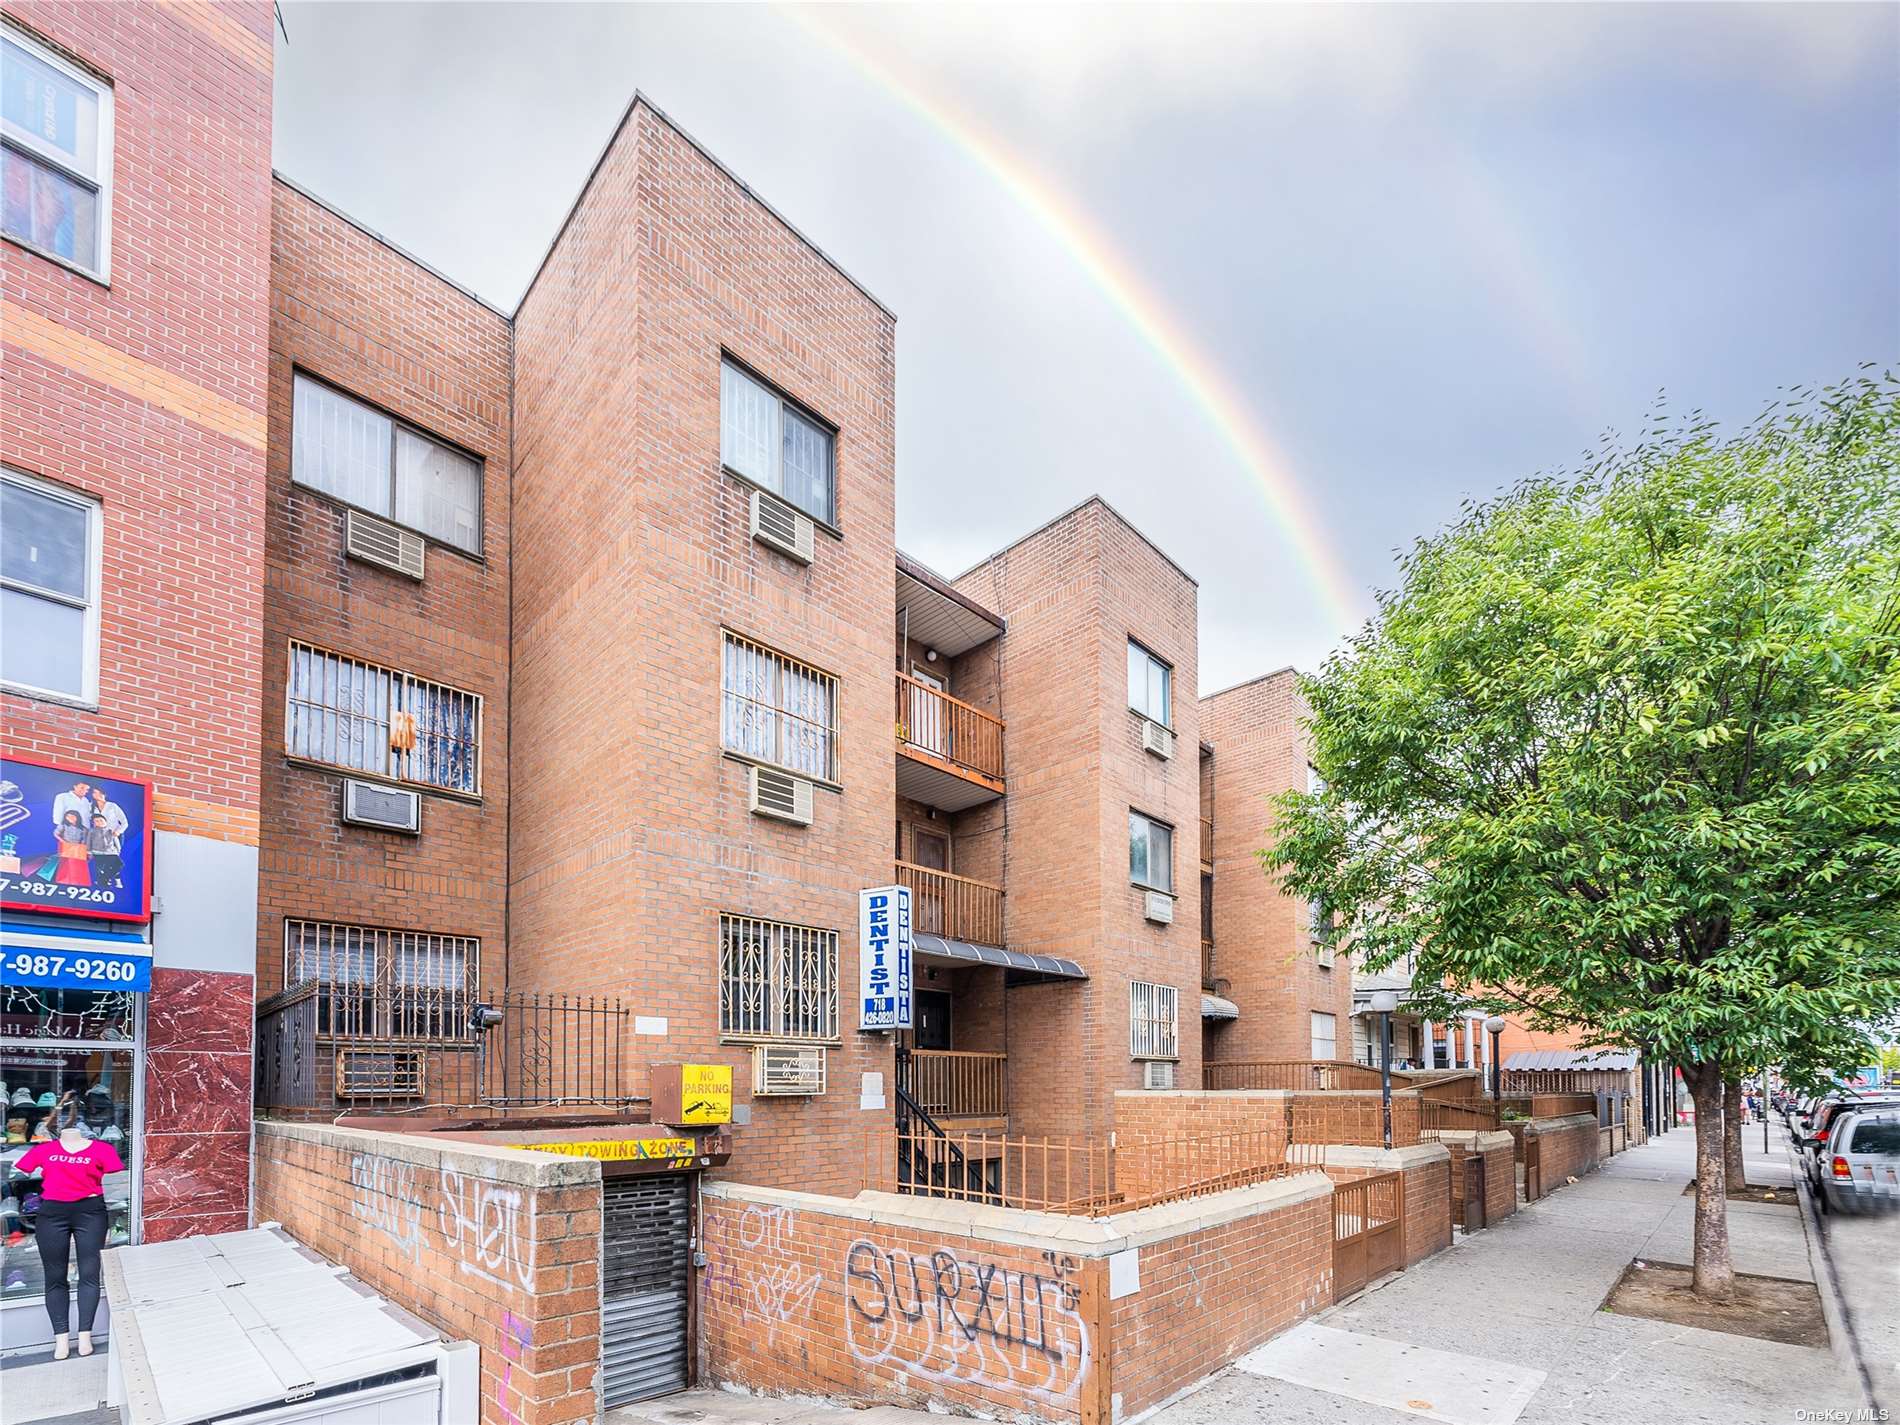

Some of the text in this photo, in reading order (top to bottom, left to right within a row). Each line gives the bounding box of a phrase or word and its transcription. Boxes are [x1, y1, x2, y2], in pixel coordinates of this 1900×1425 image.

[869, 895, 890, 996] DENTIST
[899, 894, 910, 1022] DENTISTA
[874, 998, 886, 1010] 718
[700, 1071, 714, 1081] NO
[685, 1083, 729, 1094] PARKING
[577, 1143, 641, 1158] TOWING
[650, 1140, 688, 1156] ZONE
[48, 1155, 92, 1164] GUESS
